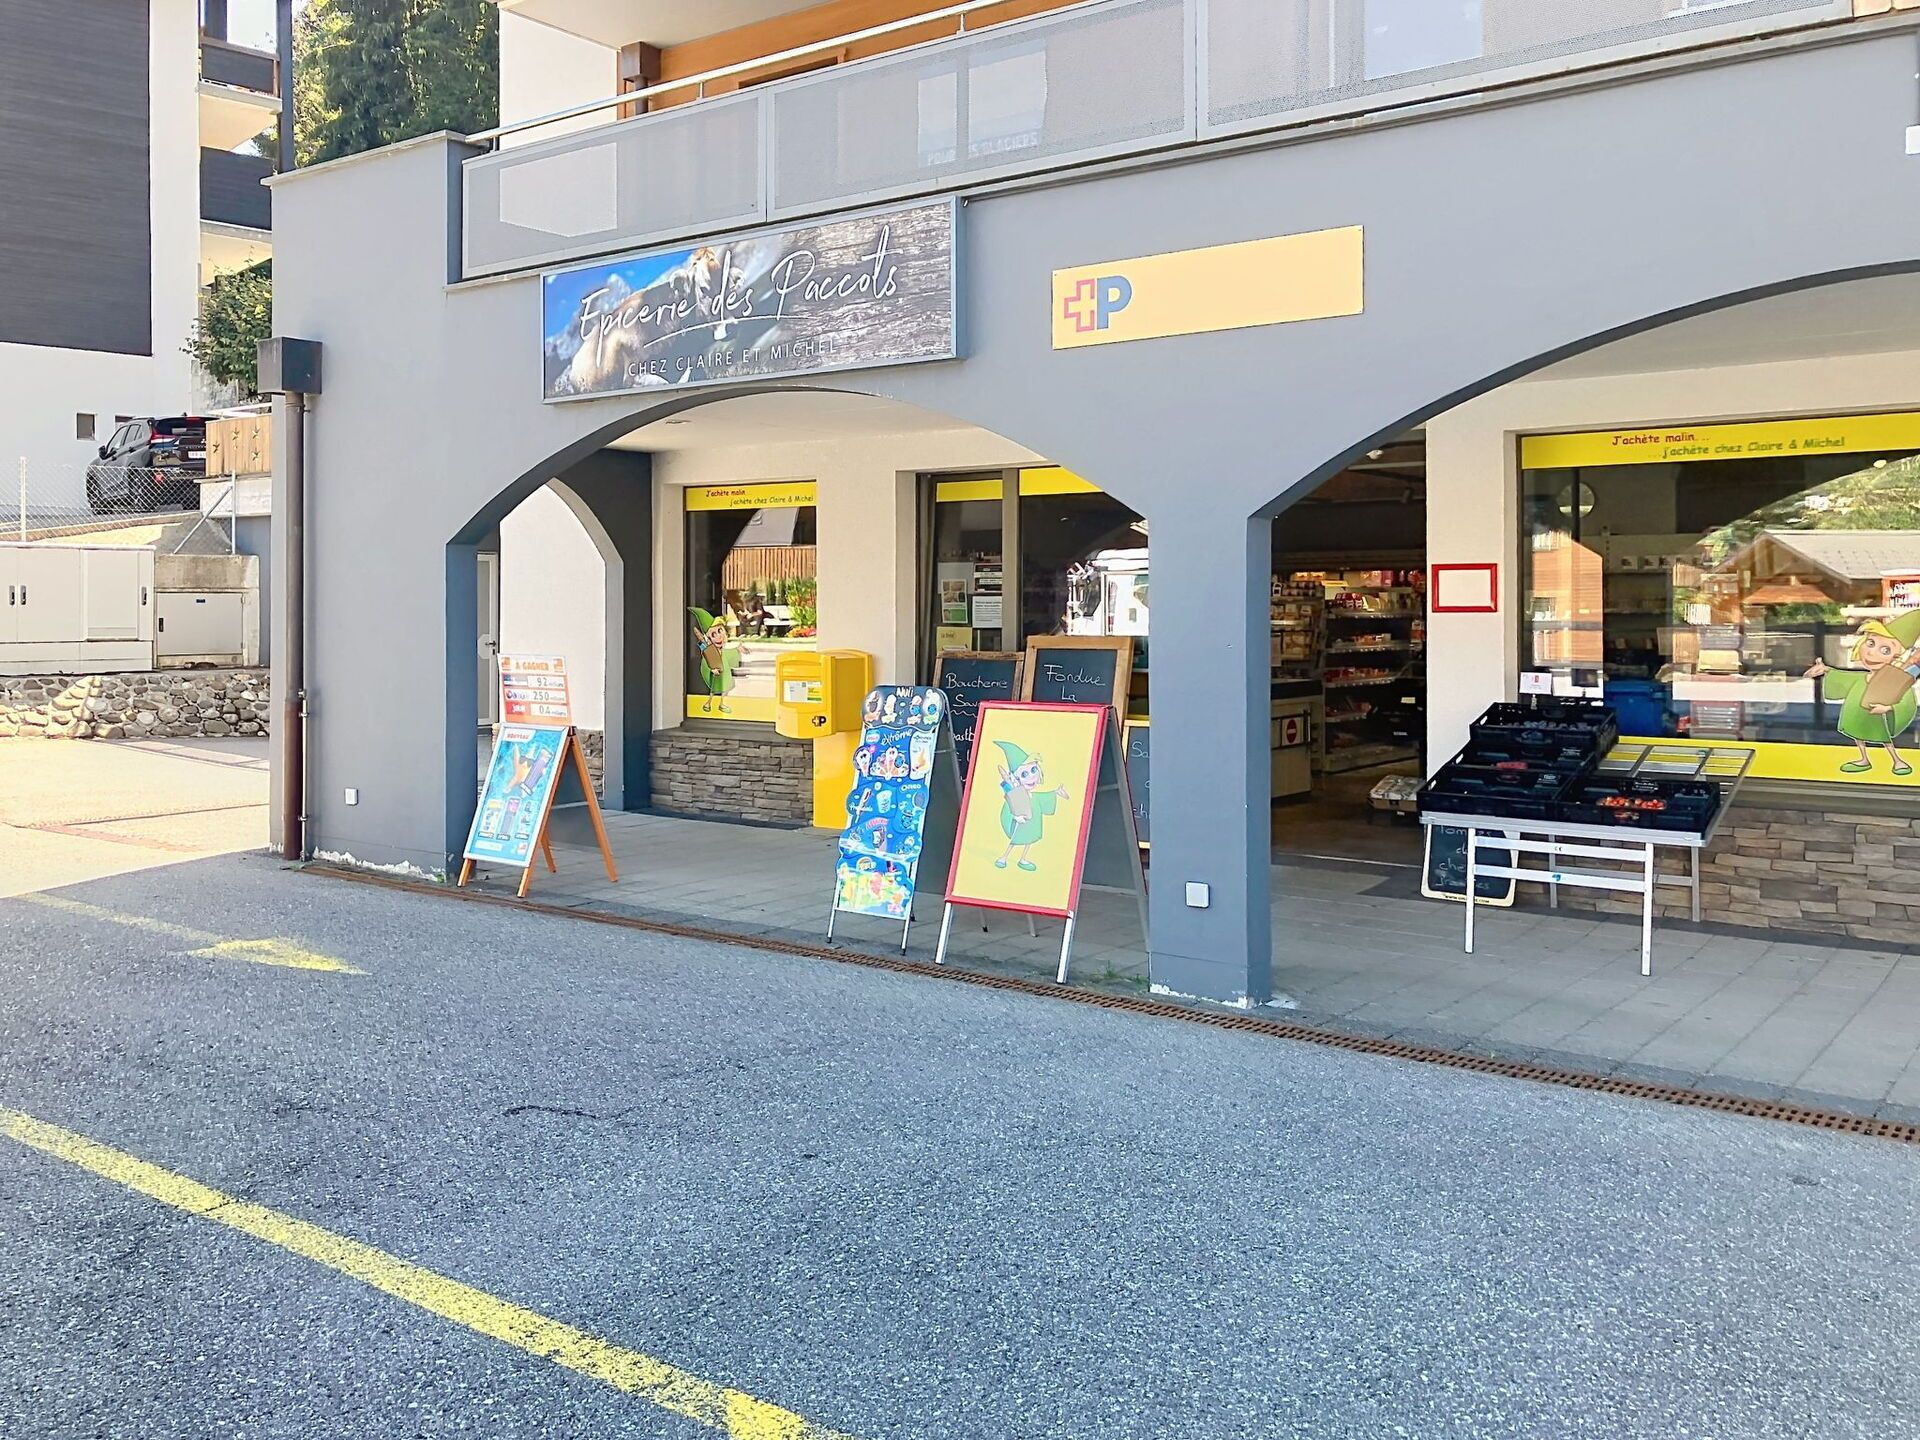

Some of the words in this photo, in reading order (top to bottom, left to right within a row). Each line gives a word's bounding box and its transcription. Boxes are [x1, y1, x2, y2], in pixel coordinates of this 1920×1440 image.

[580, 288, 698, 368] Epicerie
[711, 250, 754, 321] des
[771, 224, 903, 321] Paccots
[628, 359, 667, 377] CHEZ
[676, 351, 733, 371] CLAIRE
[743, 347, 761, 363] ET
[770, 339, 837, 360] MICHEL
[1714, 444, 1742, 453] chez
[1747, 441, 1783, 451] Claire
[1789, 439, 1797, 449] &
[1803, 436, 1845, 448] Michel
[945, 672, 1008, 689] Boucherie
[1043, 664, 1106, 686] Fondue
[1061, 684, 1078, 702] La
